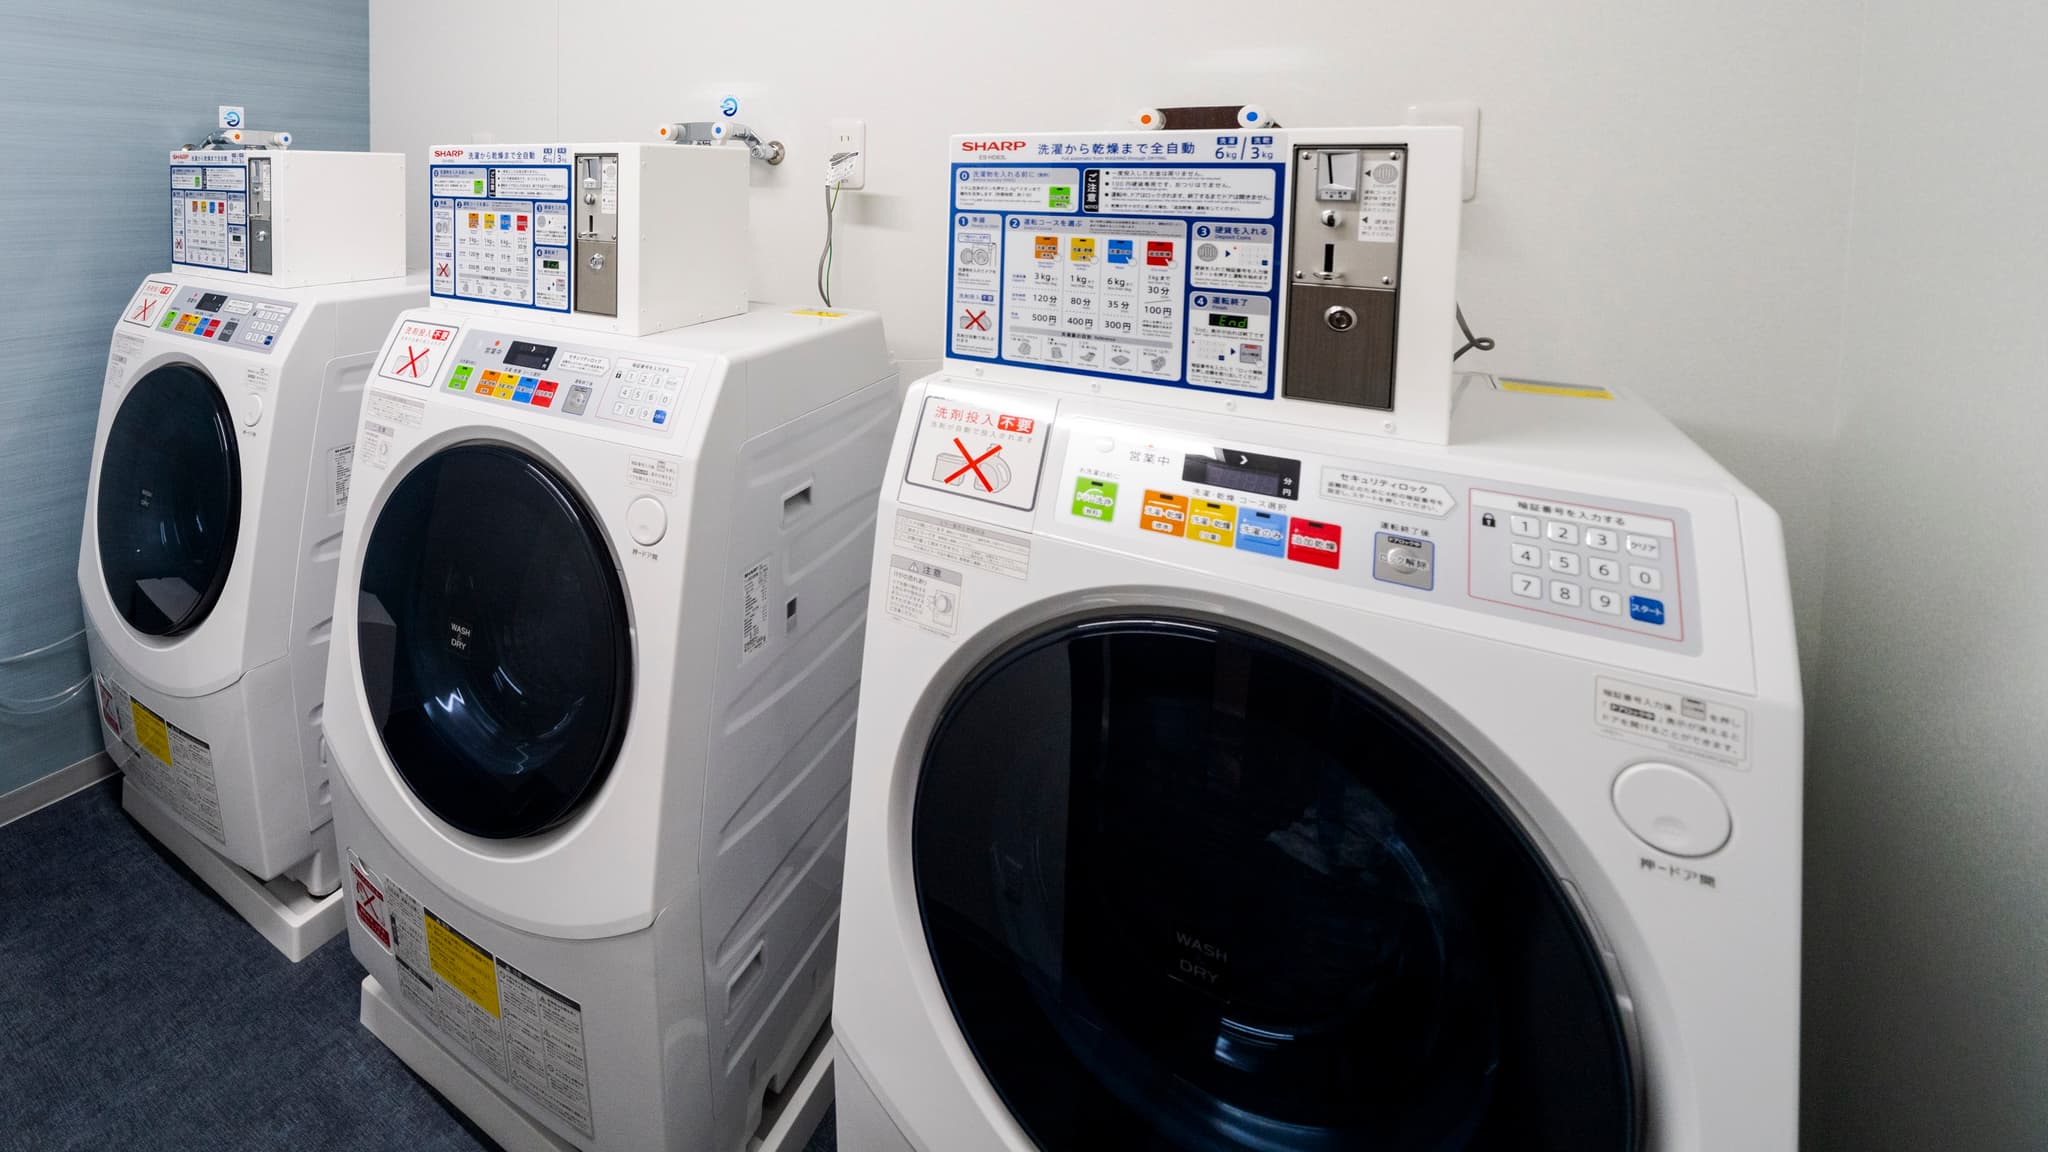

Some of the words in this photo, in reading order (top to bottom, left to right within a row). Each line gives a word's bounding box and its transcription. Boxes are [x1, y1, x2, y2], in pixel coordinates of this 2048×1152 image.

[962, 141, 1026, 152] SHARP
[1038, 142, 1195, 156] 洗濯から乾燥まで全自動
[1088, 170, 1098, 203] ご注意
[1024, 218, 1082, 227] 運転コースを選ぶ
[1215, 226, 1268, 236] 硬貨を入れる
[1147, 286, 1169, 295] 30分
[1033, 294, 1057, 303] 120分
[1070, 297, 1091, 306] 80分
[1212, 297, 1248, 306] 運転終了
[1107, 300, 1129, 310] 35分
[1145, 306, 1172, 316] 100円
[1032, 314, 1057, 323] 500円
[1067, 317, 1093, 327] 400円
[1219, 315, 1247, 328] End
[1105, 320, 1131, 331] 300円
[934, 405, 994, 428] 洗剤投入
[1000, 415, 1033, 433] 不要
[1129, 450, 1171, 467] 営業中
[1283, 477, 1293, 486] 分
[1341, 472, 1428, 494] セキュリティロック
[1282, 487, 1292, 497] 円
[1144, 505, 1185, 521] 洗濯・乾燥
[1517, 500, 1625, 526] 暗証番号を入力する
[1191, 514, 1232, 530] 洗濯・乾燥
[1522, 521, 1528, 532] 1
[1241, 524, 1283, 540] 洗濯のみ
[1381, 521, 1430, 537] 運転終了後
[1559, 527, 1568, 539] 2
[1291, 535, 1337, 551] 追加乾燥
[1599, 534, 1607, 546] 3
[1521, 550, 1531, 561] 4
[1560, 557, 1569, 569] 5
[1599, 564, 1609, 577] 6
[1639, 571, 1651, 584] 0
[1522, 580, 1532, 592] 7
[1560, 587, 1570, 600] 8
[1600, 595, 1611, 607] 9
[1630, 602, 1665, 617] スタート
[451, 622, 471, 637] WASH
[450, 638, 467, 650] DRY
[1176, 930, 1228, 964] WASH
[1179, 958, 1219, 985] DRY
